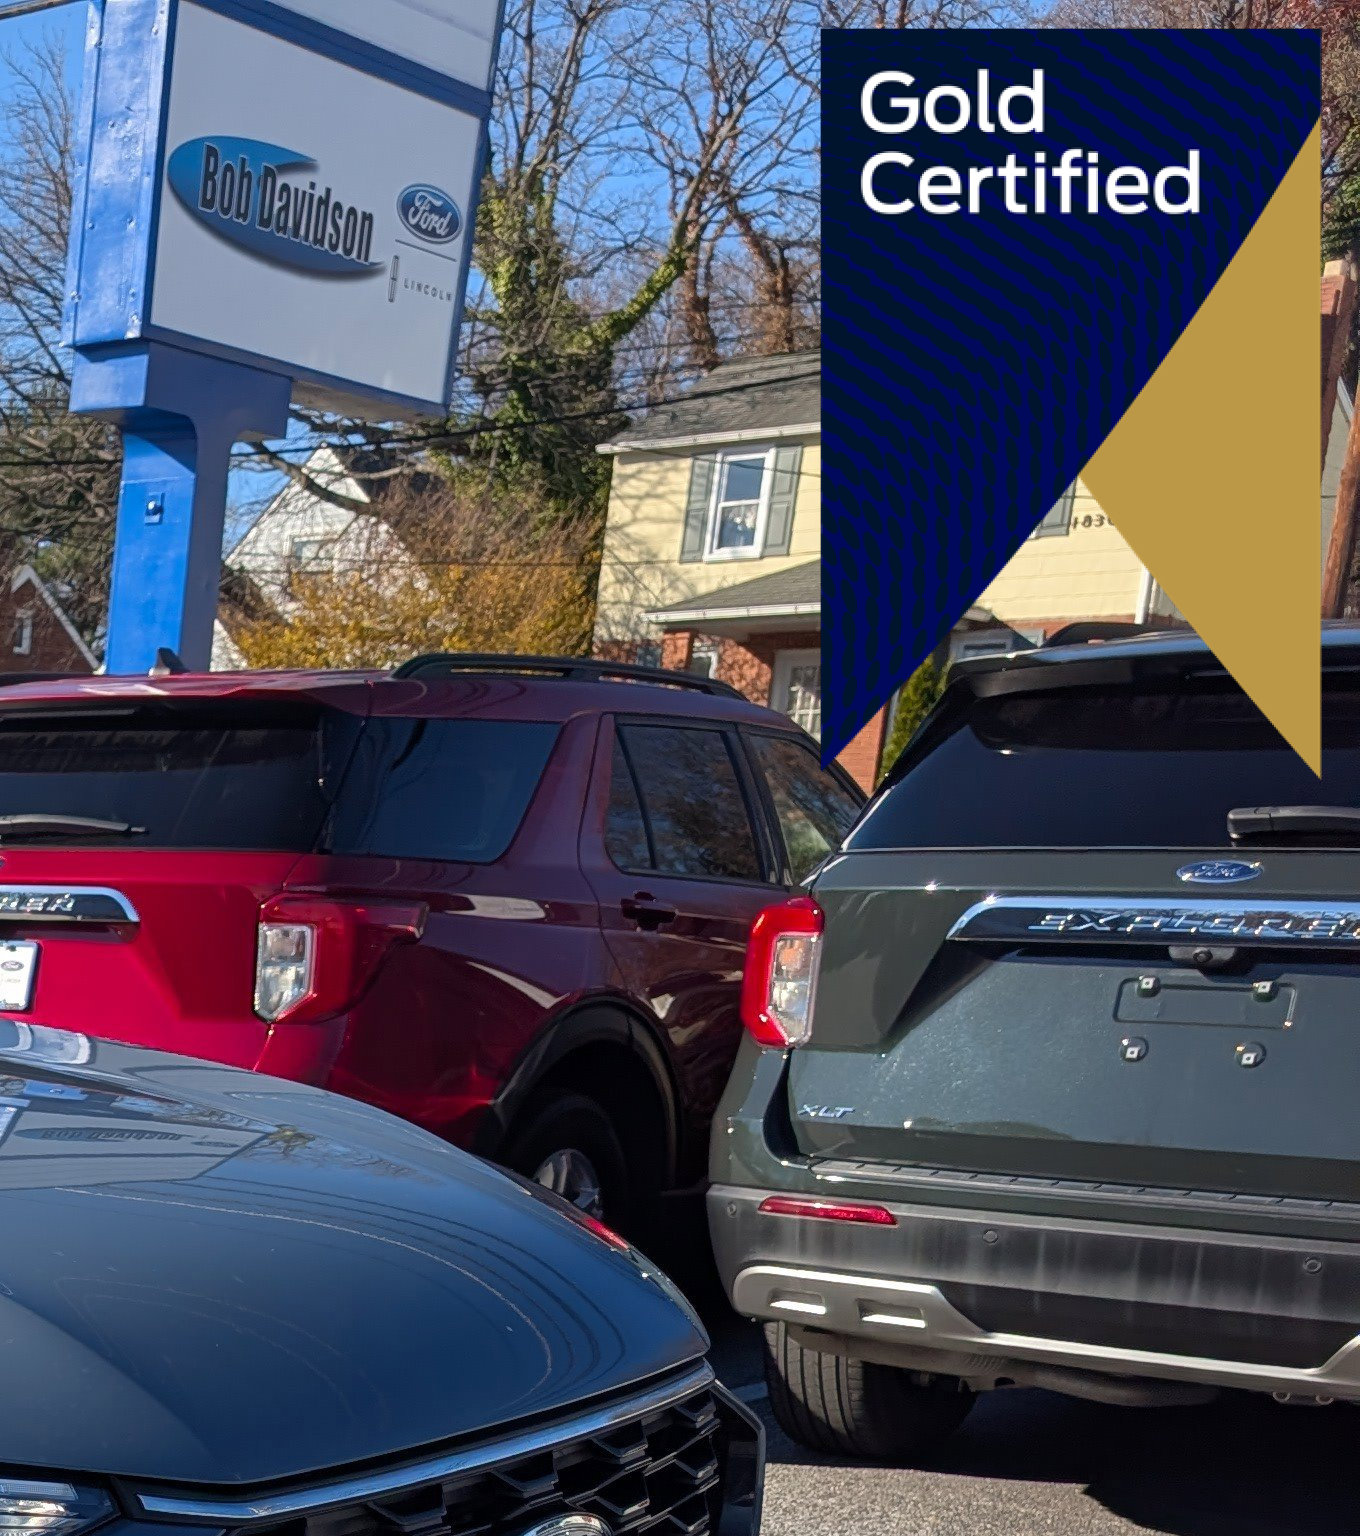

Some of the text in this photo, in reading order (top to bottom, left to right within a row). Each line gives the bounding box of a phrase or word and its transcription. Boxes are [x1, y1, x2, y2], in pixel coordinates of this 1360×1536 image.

[198, 141, 376, 263] Bob Davidson
[411, 190, 450, 237] Ford
[403, 277, 454, 302] LINCOLN
[797, 1104, 856, 1118] XLT
